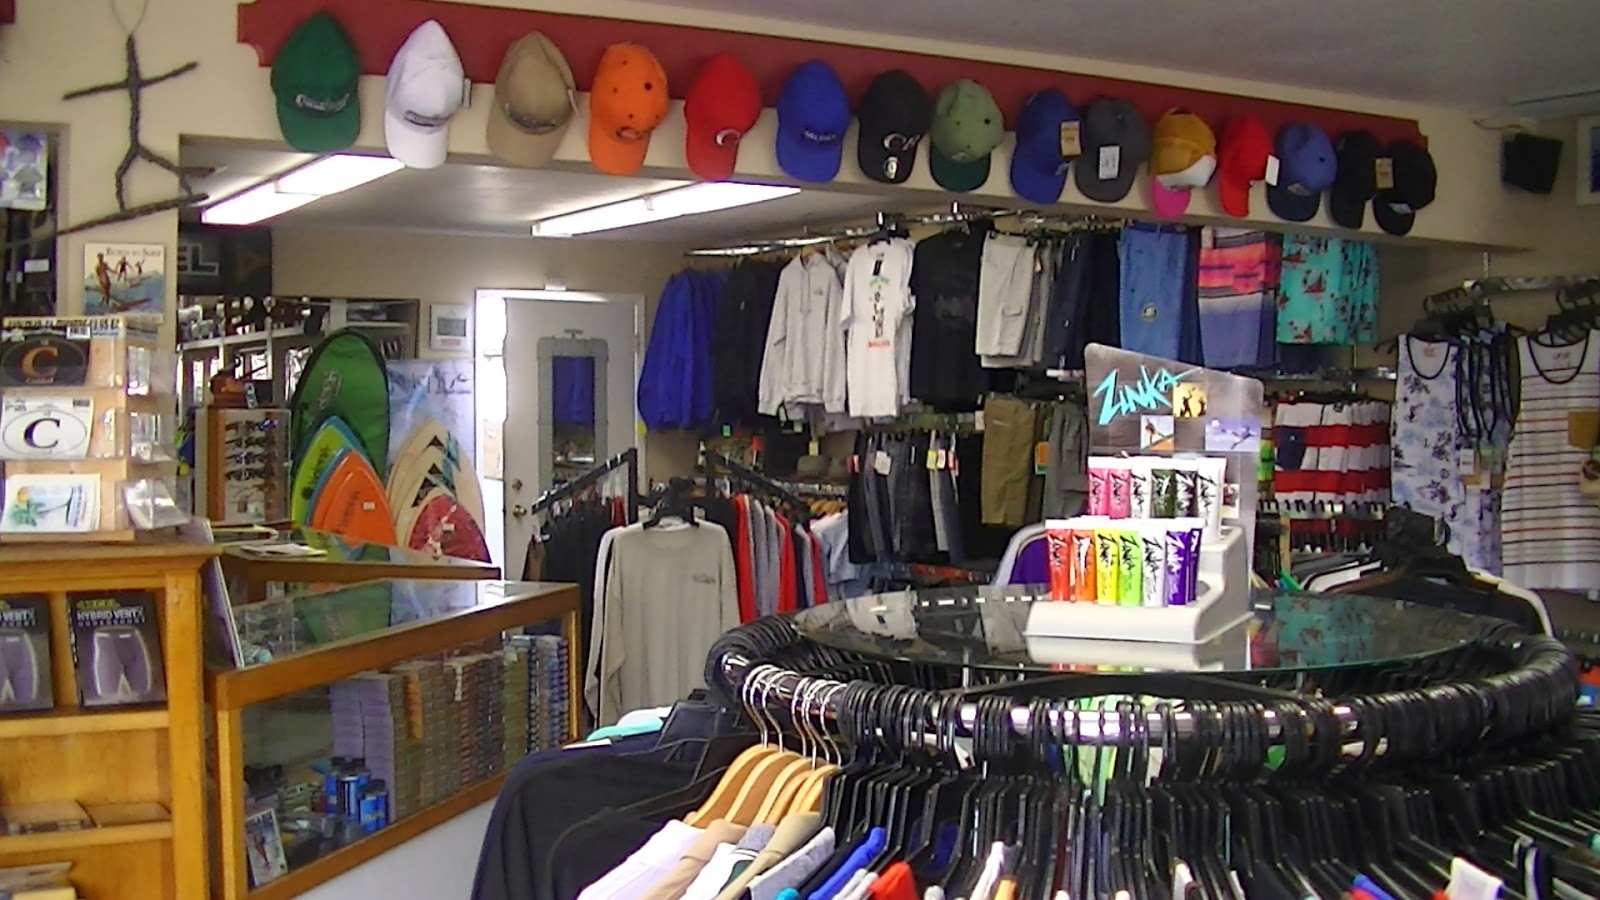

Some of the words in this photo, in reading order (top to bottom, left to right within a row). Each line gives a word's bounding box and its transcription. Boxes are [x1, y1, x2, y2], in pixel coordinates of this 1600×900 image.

[22, 346, 58, 379] C
[1092, 365, 1202, 425] ZINKA
[24, 418, 60, 449] C
